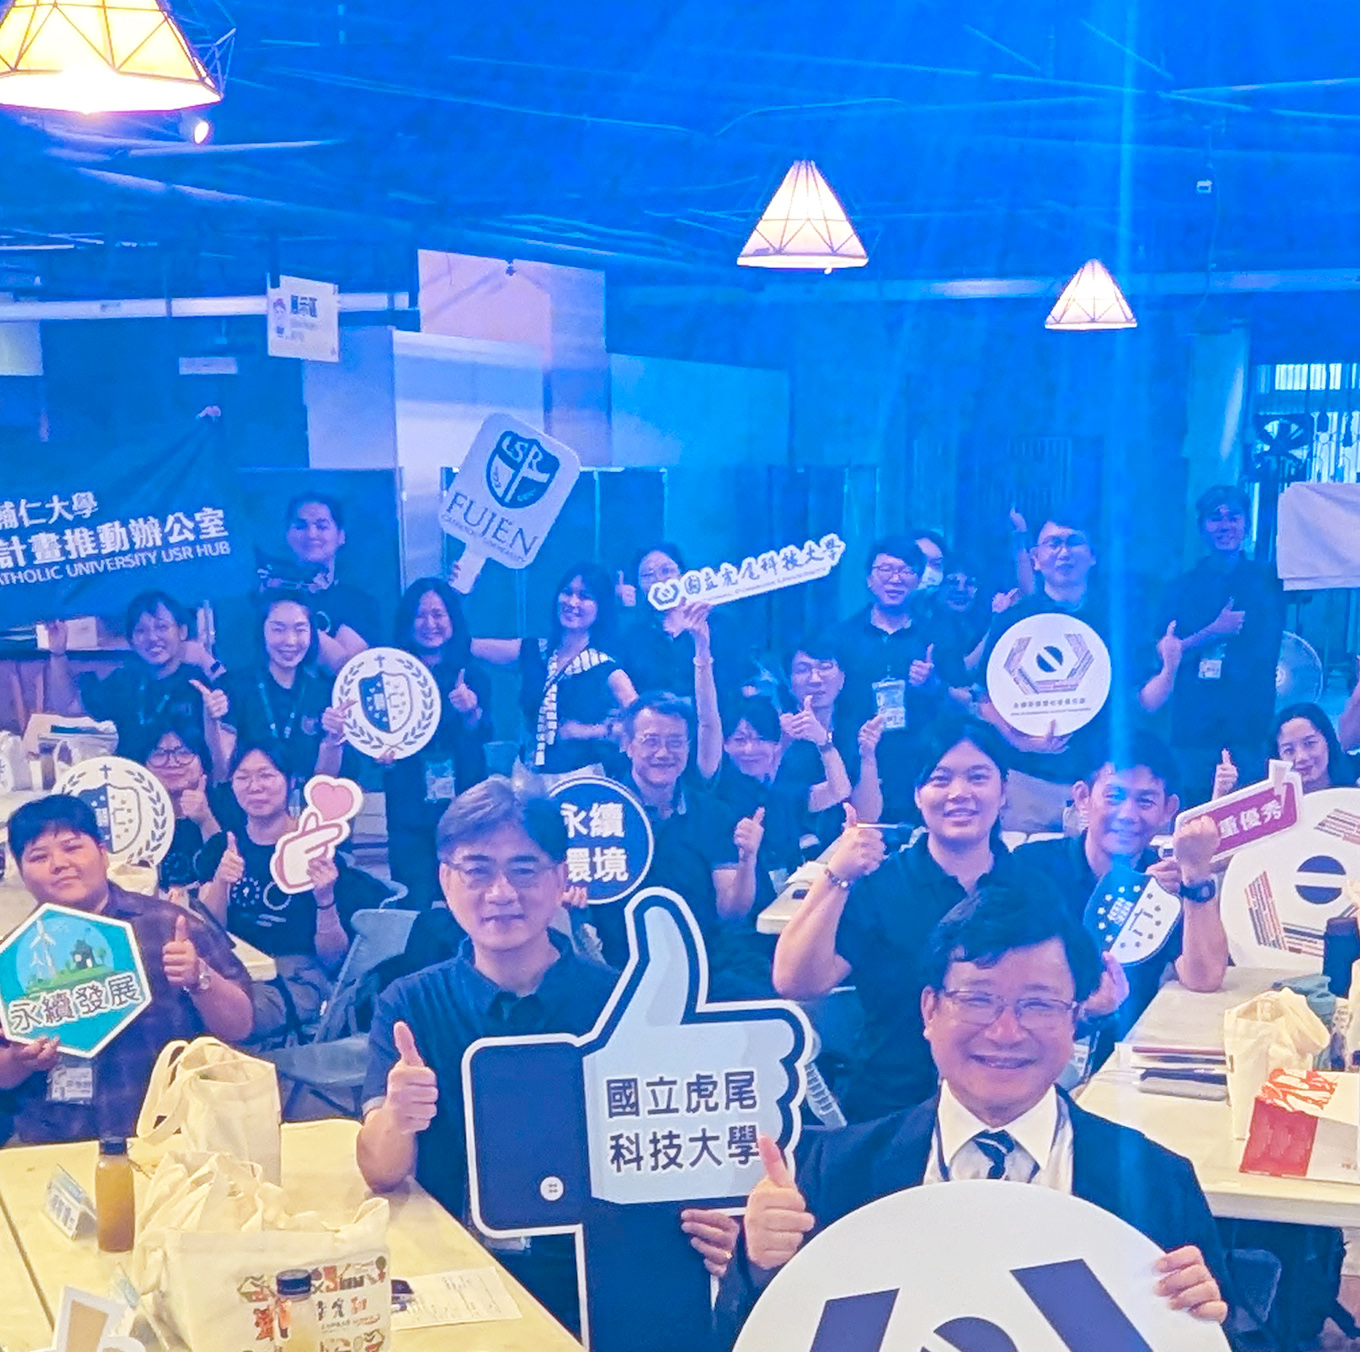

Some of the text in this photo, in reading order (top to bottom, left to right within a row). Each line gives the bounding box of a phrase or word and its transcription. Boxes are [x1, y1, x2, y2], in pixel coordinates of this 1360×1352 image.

[446, 491, 538, 556] FUJEN
[67, 551, 158, 578] UNIVERSITY
[161, 547, 195, 564] USR
[197, 541, 231, 558] HUB
[560, 802, 626, 839] 永續
[1218, 799, 1282, 839] 重優秀
[9, 973, 142, 1034] 永續發展
[605, 1070, 759, 1120] 國立虎尾
[608, 1124, 761, 1173] 科技大學
